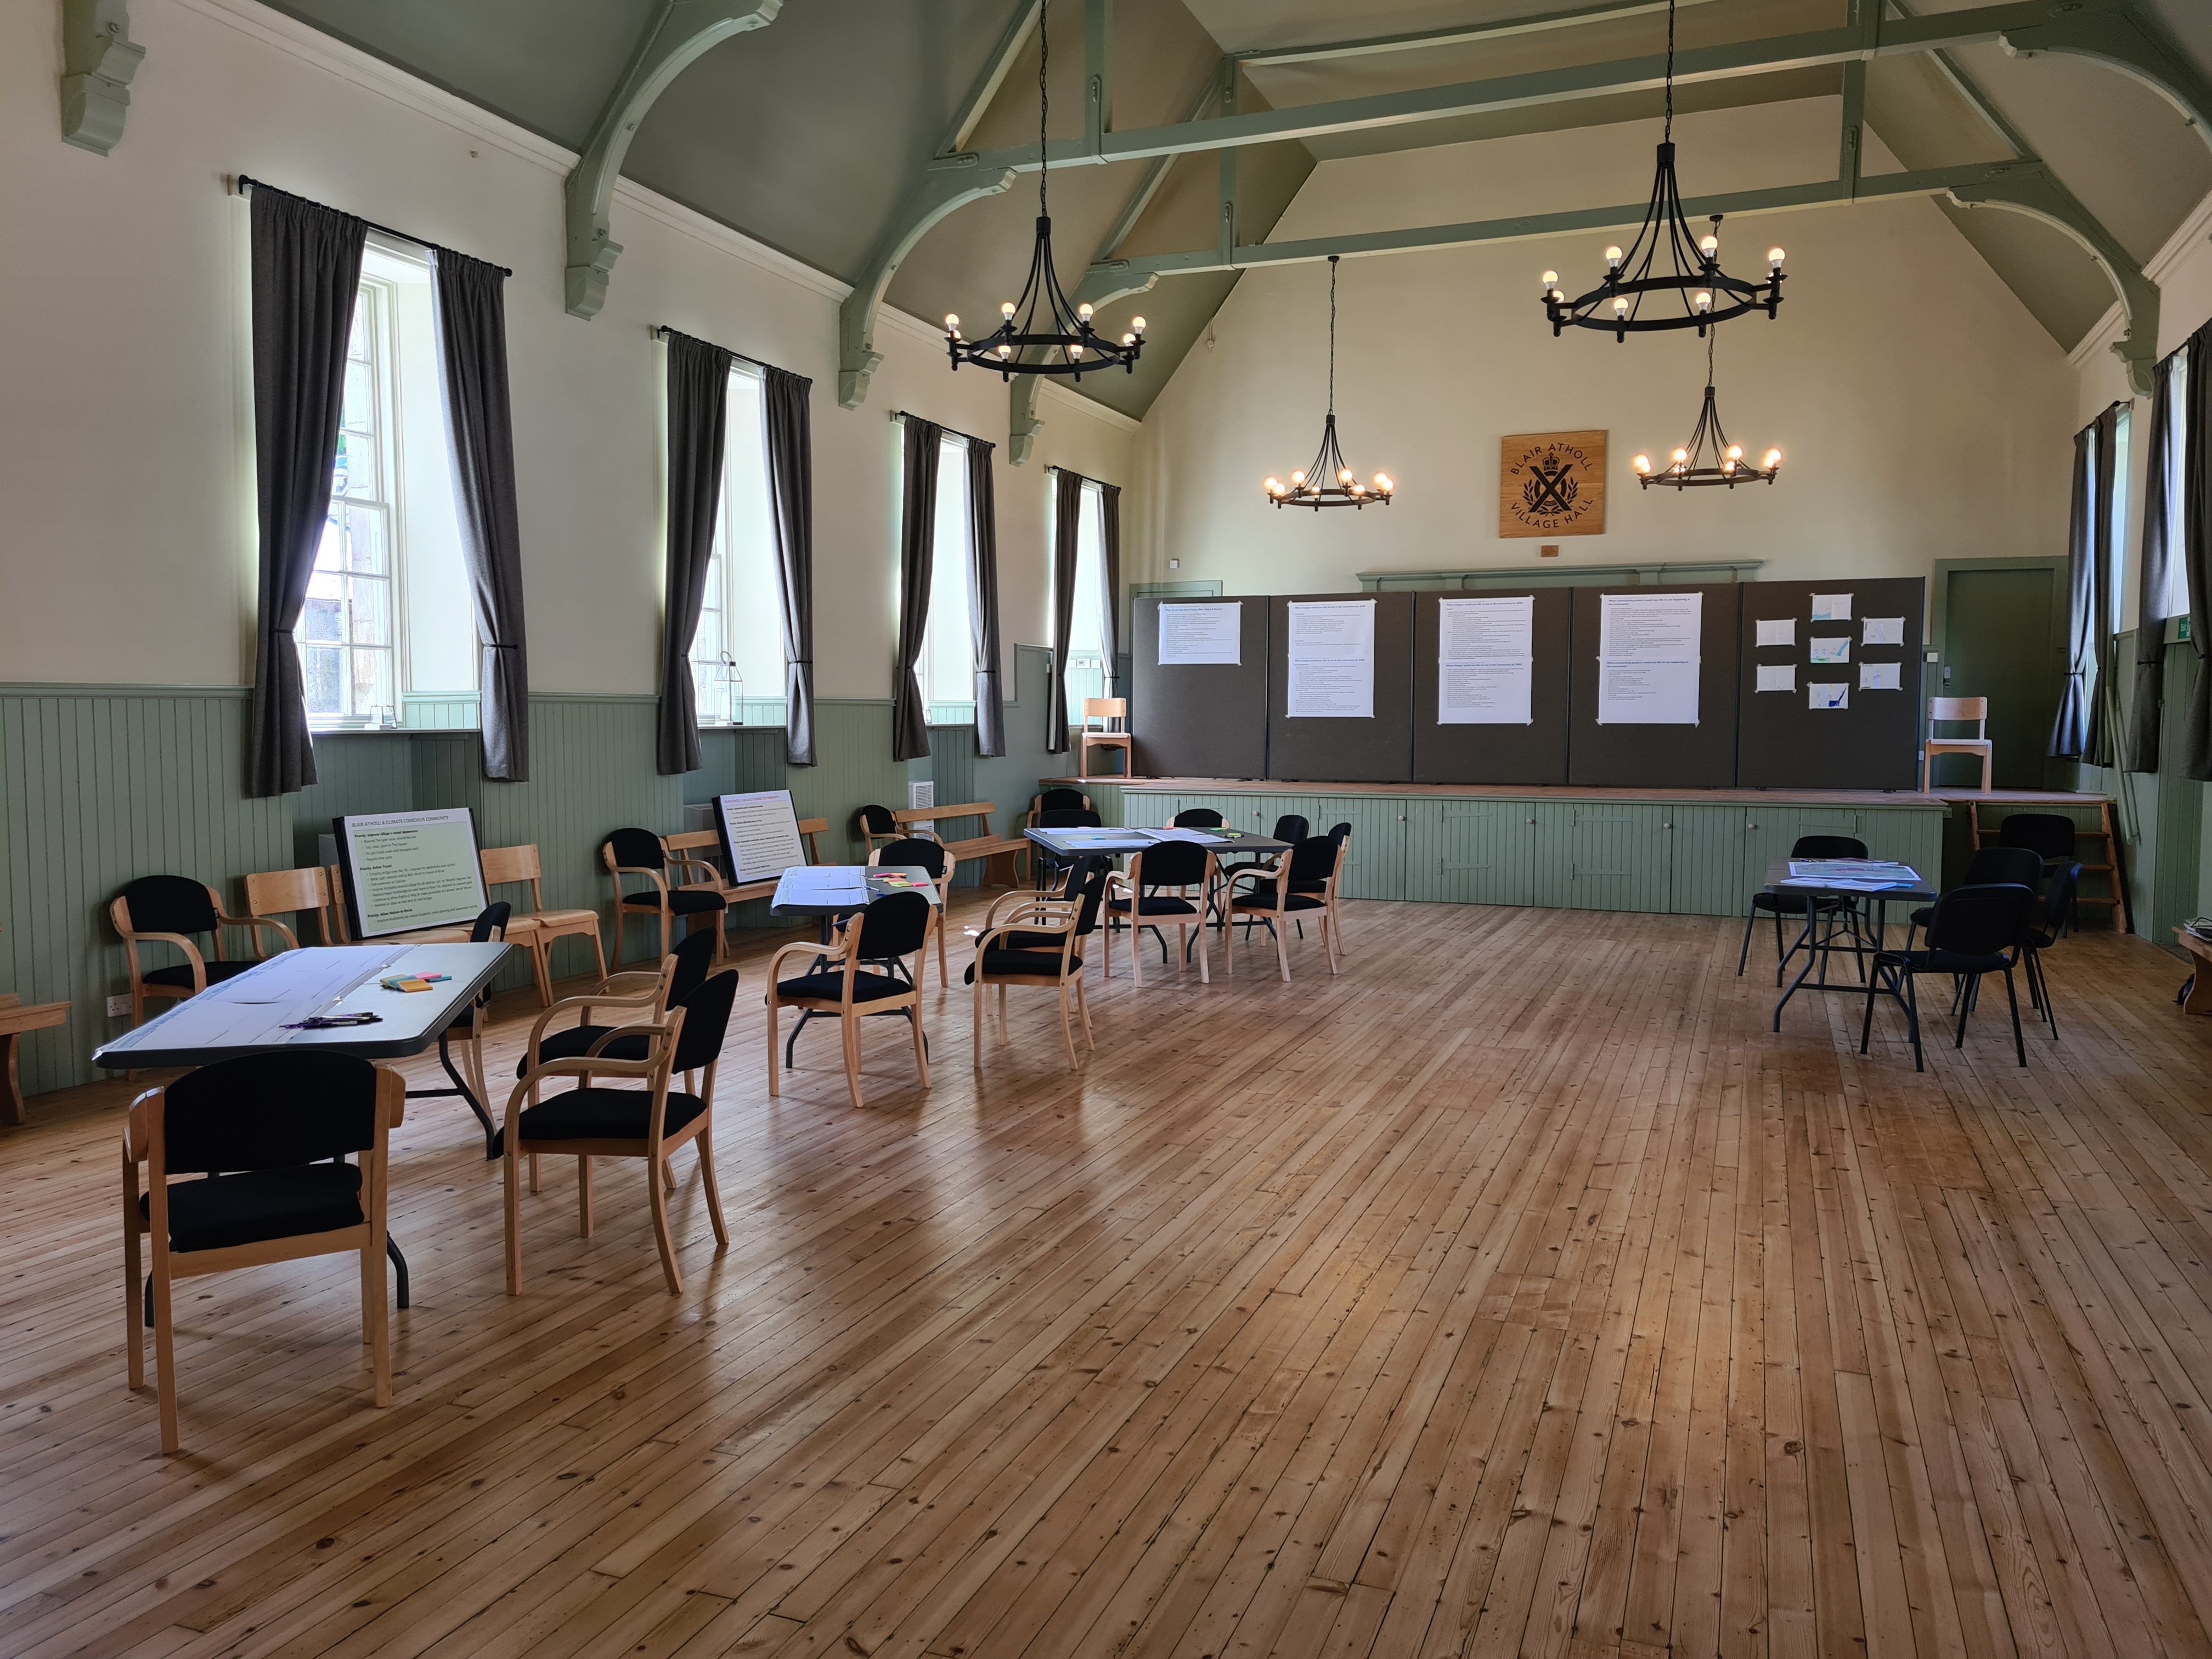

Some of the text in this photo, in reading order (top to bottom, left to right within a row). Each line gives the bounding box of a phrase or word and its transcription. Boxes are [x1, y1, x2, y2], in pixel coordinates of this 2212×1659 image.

[1510, 443, 1593, 475] BLAIR ATHOLL
[1511, 499, 1593, 528] VILLAGE HALL
